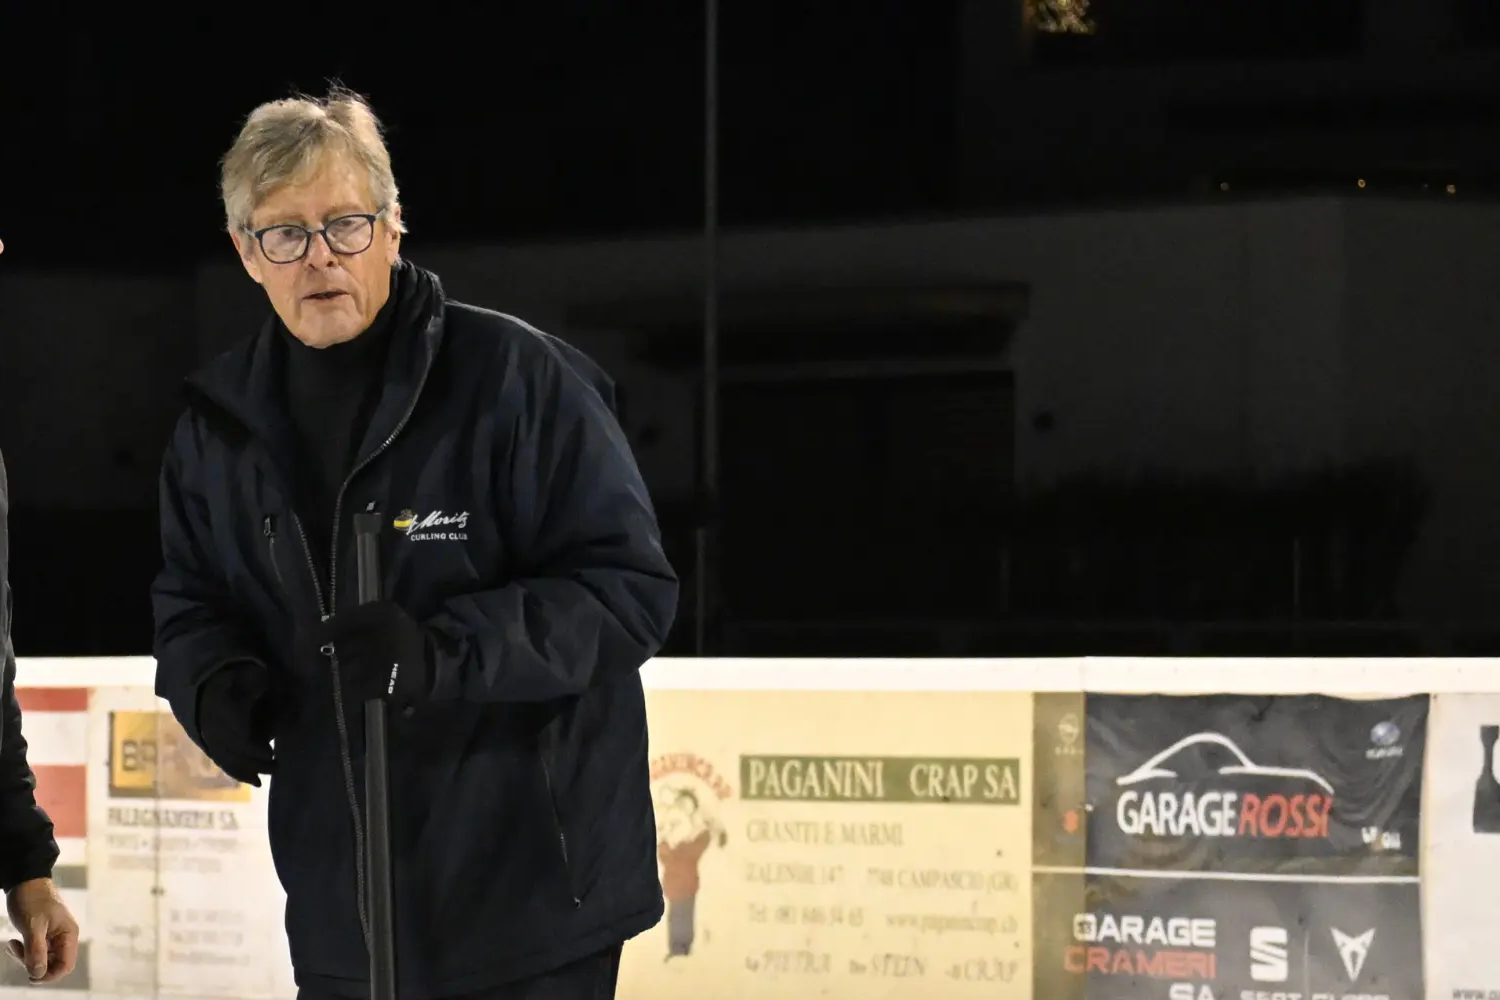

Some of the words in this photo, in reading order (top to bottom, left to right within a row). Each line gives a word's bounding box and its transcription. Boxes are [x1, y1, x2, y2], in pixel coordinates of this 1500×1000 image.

[411, 533, 446, 541] CURLING
[448, 532, 468, 540] CLUB
[387, 662, 399, 695] HEAD
[747, 757, 884, 799] PAGANINI
[909, 763, 978, 799] CRAP
[984, 765, 1016, 799] SA
[1116, 789, 1239, 838] GARAGE
[1238, 793, 1333, 839] ROSSI
[1073, 912, 1217, 948] GARAGE
[1063, 945, 1217, 980] CRAMERI
